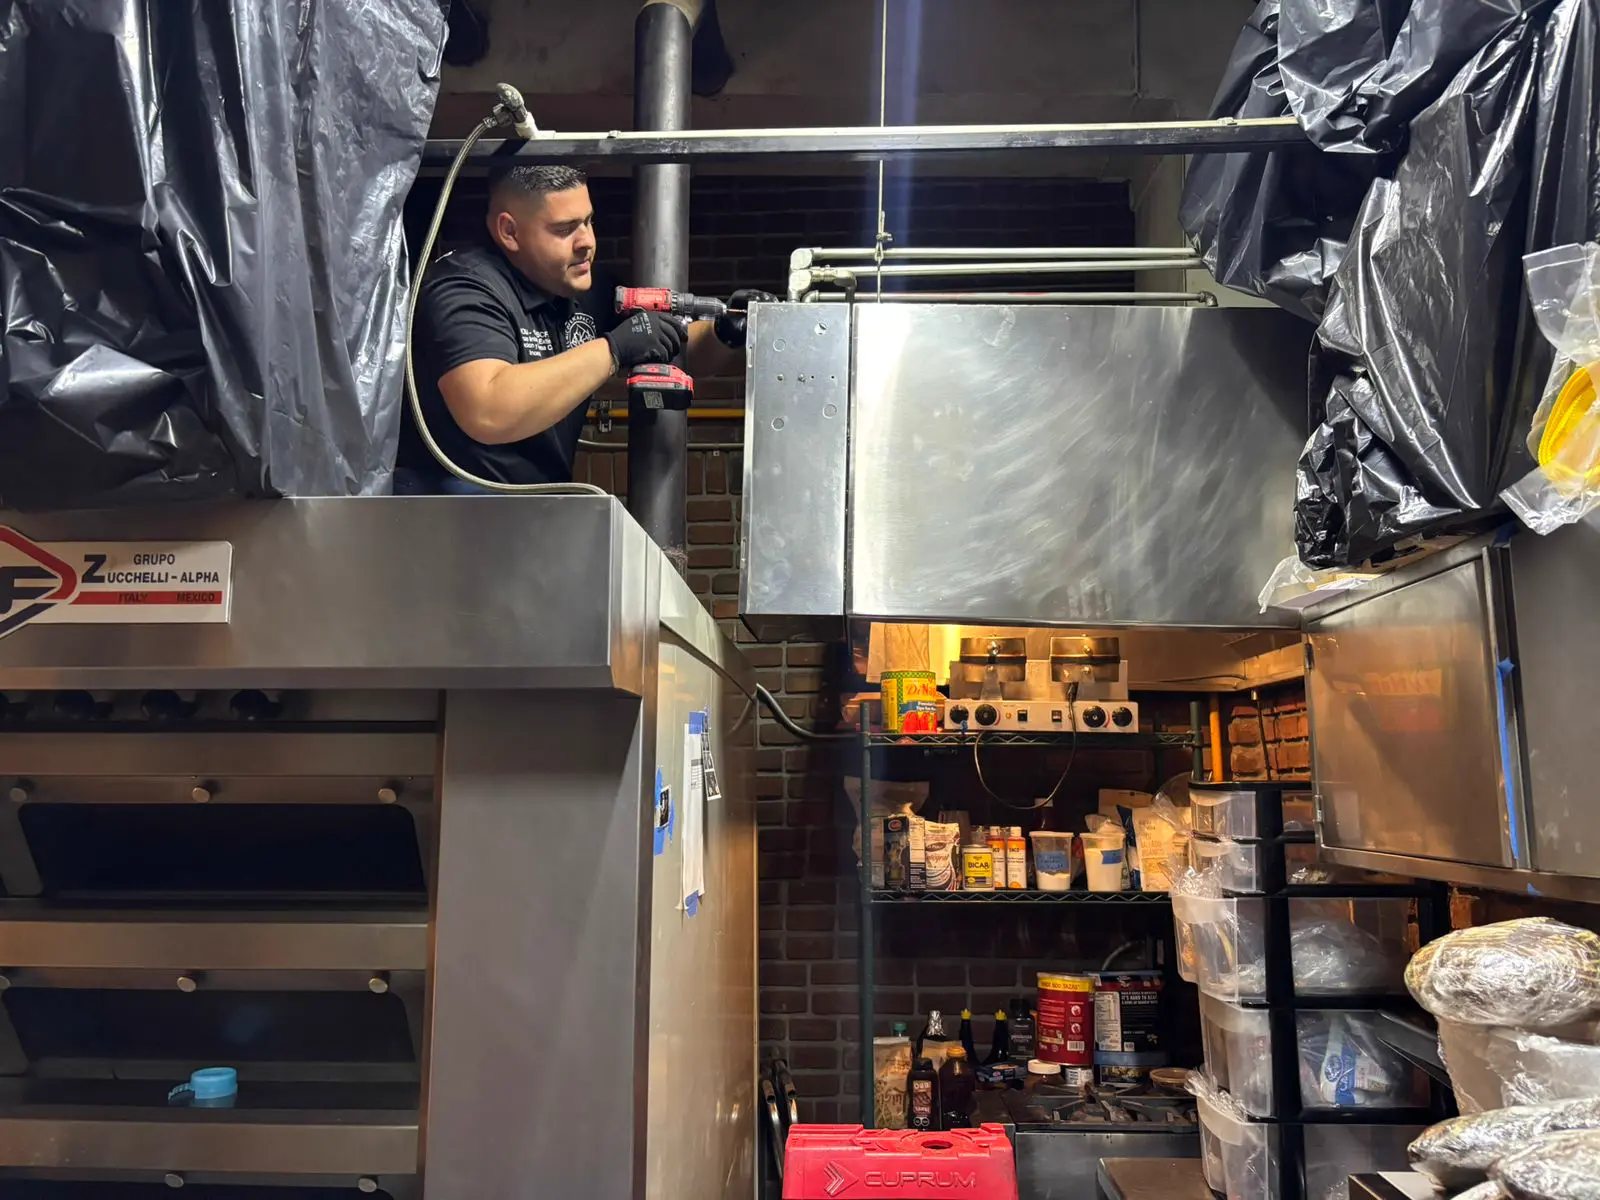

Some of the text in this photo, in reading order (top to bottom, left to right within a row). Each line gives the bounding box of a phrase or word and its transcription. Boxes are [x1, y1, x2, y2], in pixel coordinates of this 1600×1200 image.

[133, 553, 176, 566] GRUPO
[119, 592, 216, 603] ITALY MEXICO
[863, 1171, 978, 1189] CUPRUM
